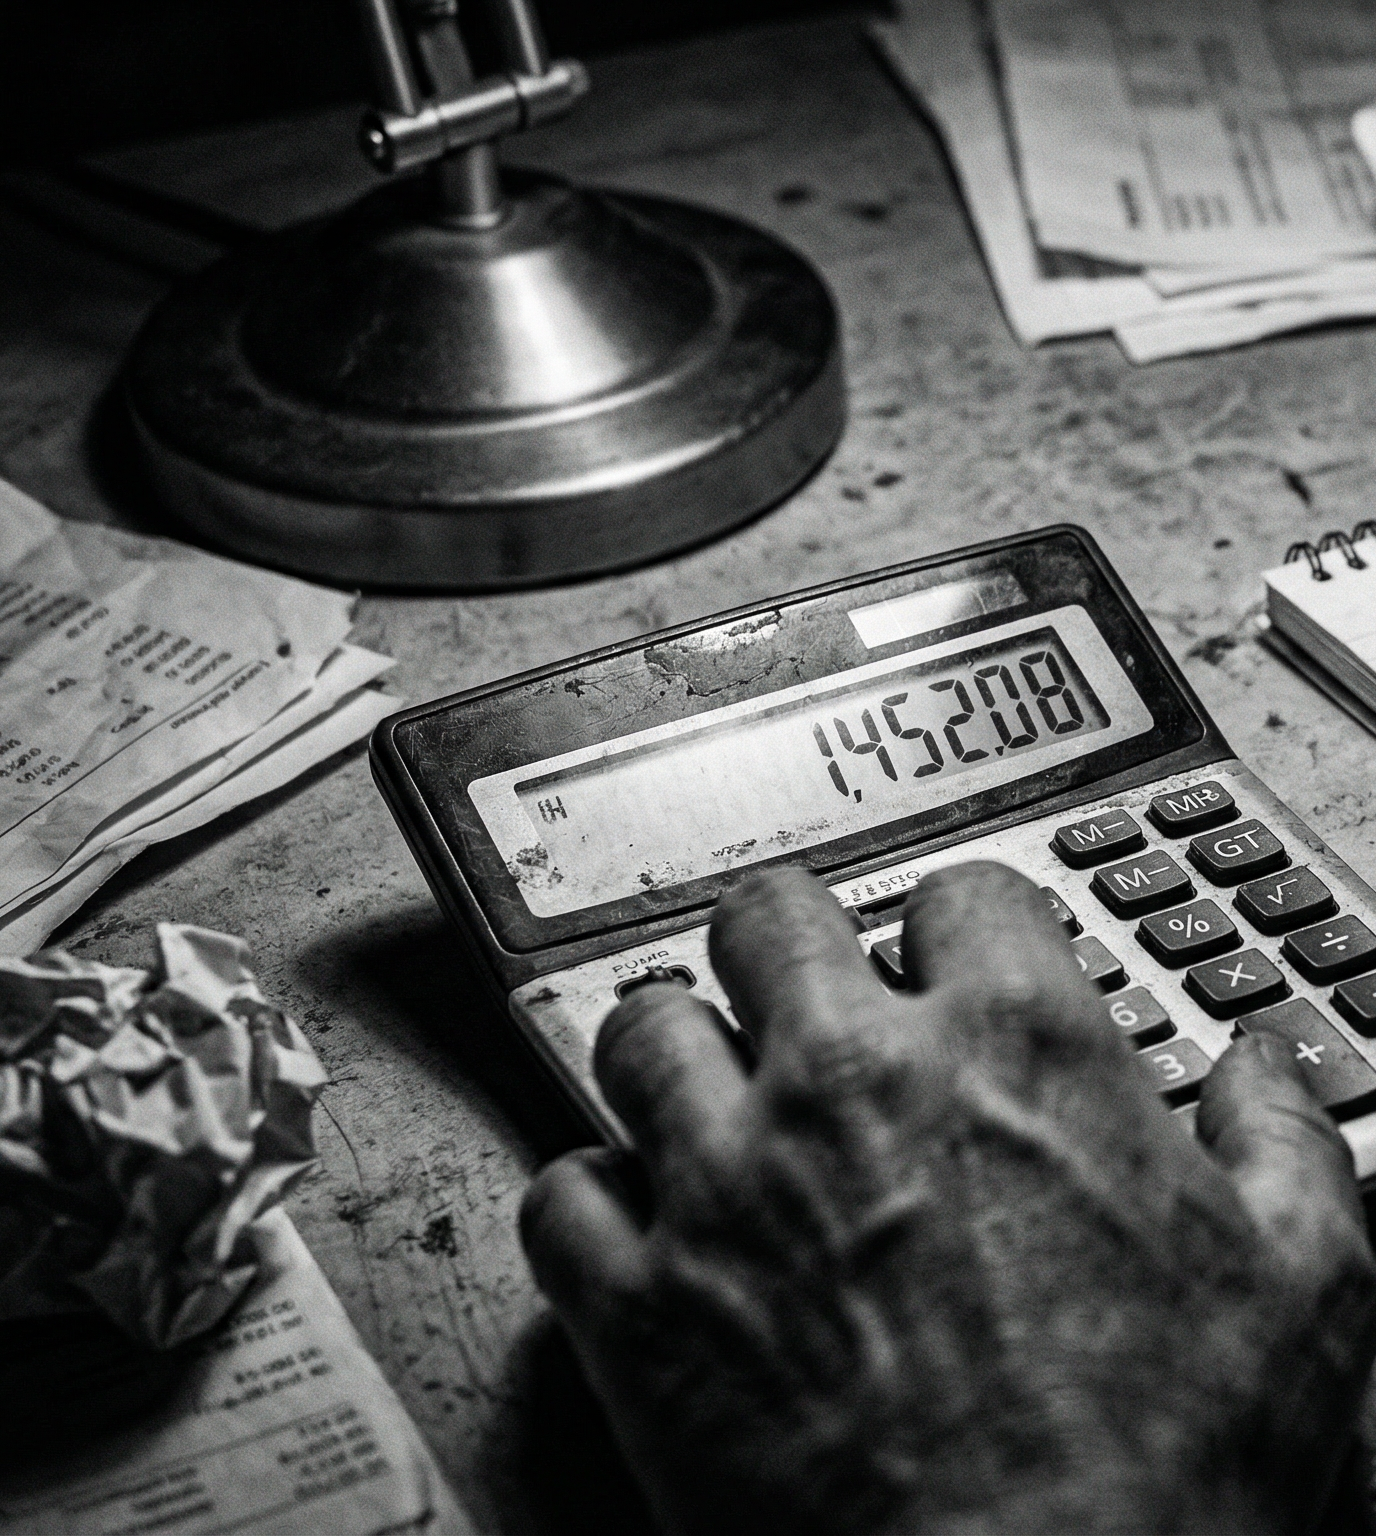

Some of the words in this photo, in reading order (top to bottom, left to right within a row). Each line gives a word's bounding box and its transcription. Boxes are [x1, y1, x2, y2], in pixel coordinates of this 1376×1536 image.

[1213, 826, 1261, 858] GT
[1168, 913, 1210, 939] %
[1109, 1001, 1138, 1027] 6
[1152, 1053, 1186, 1081] 3
